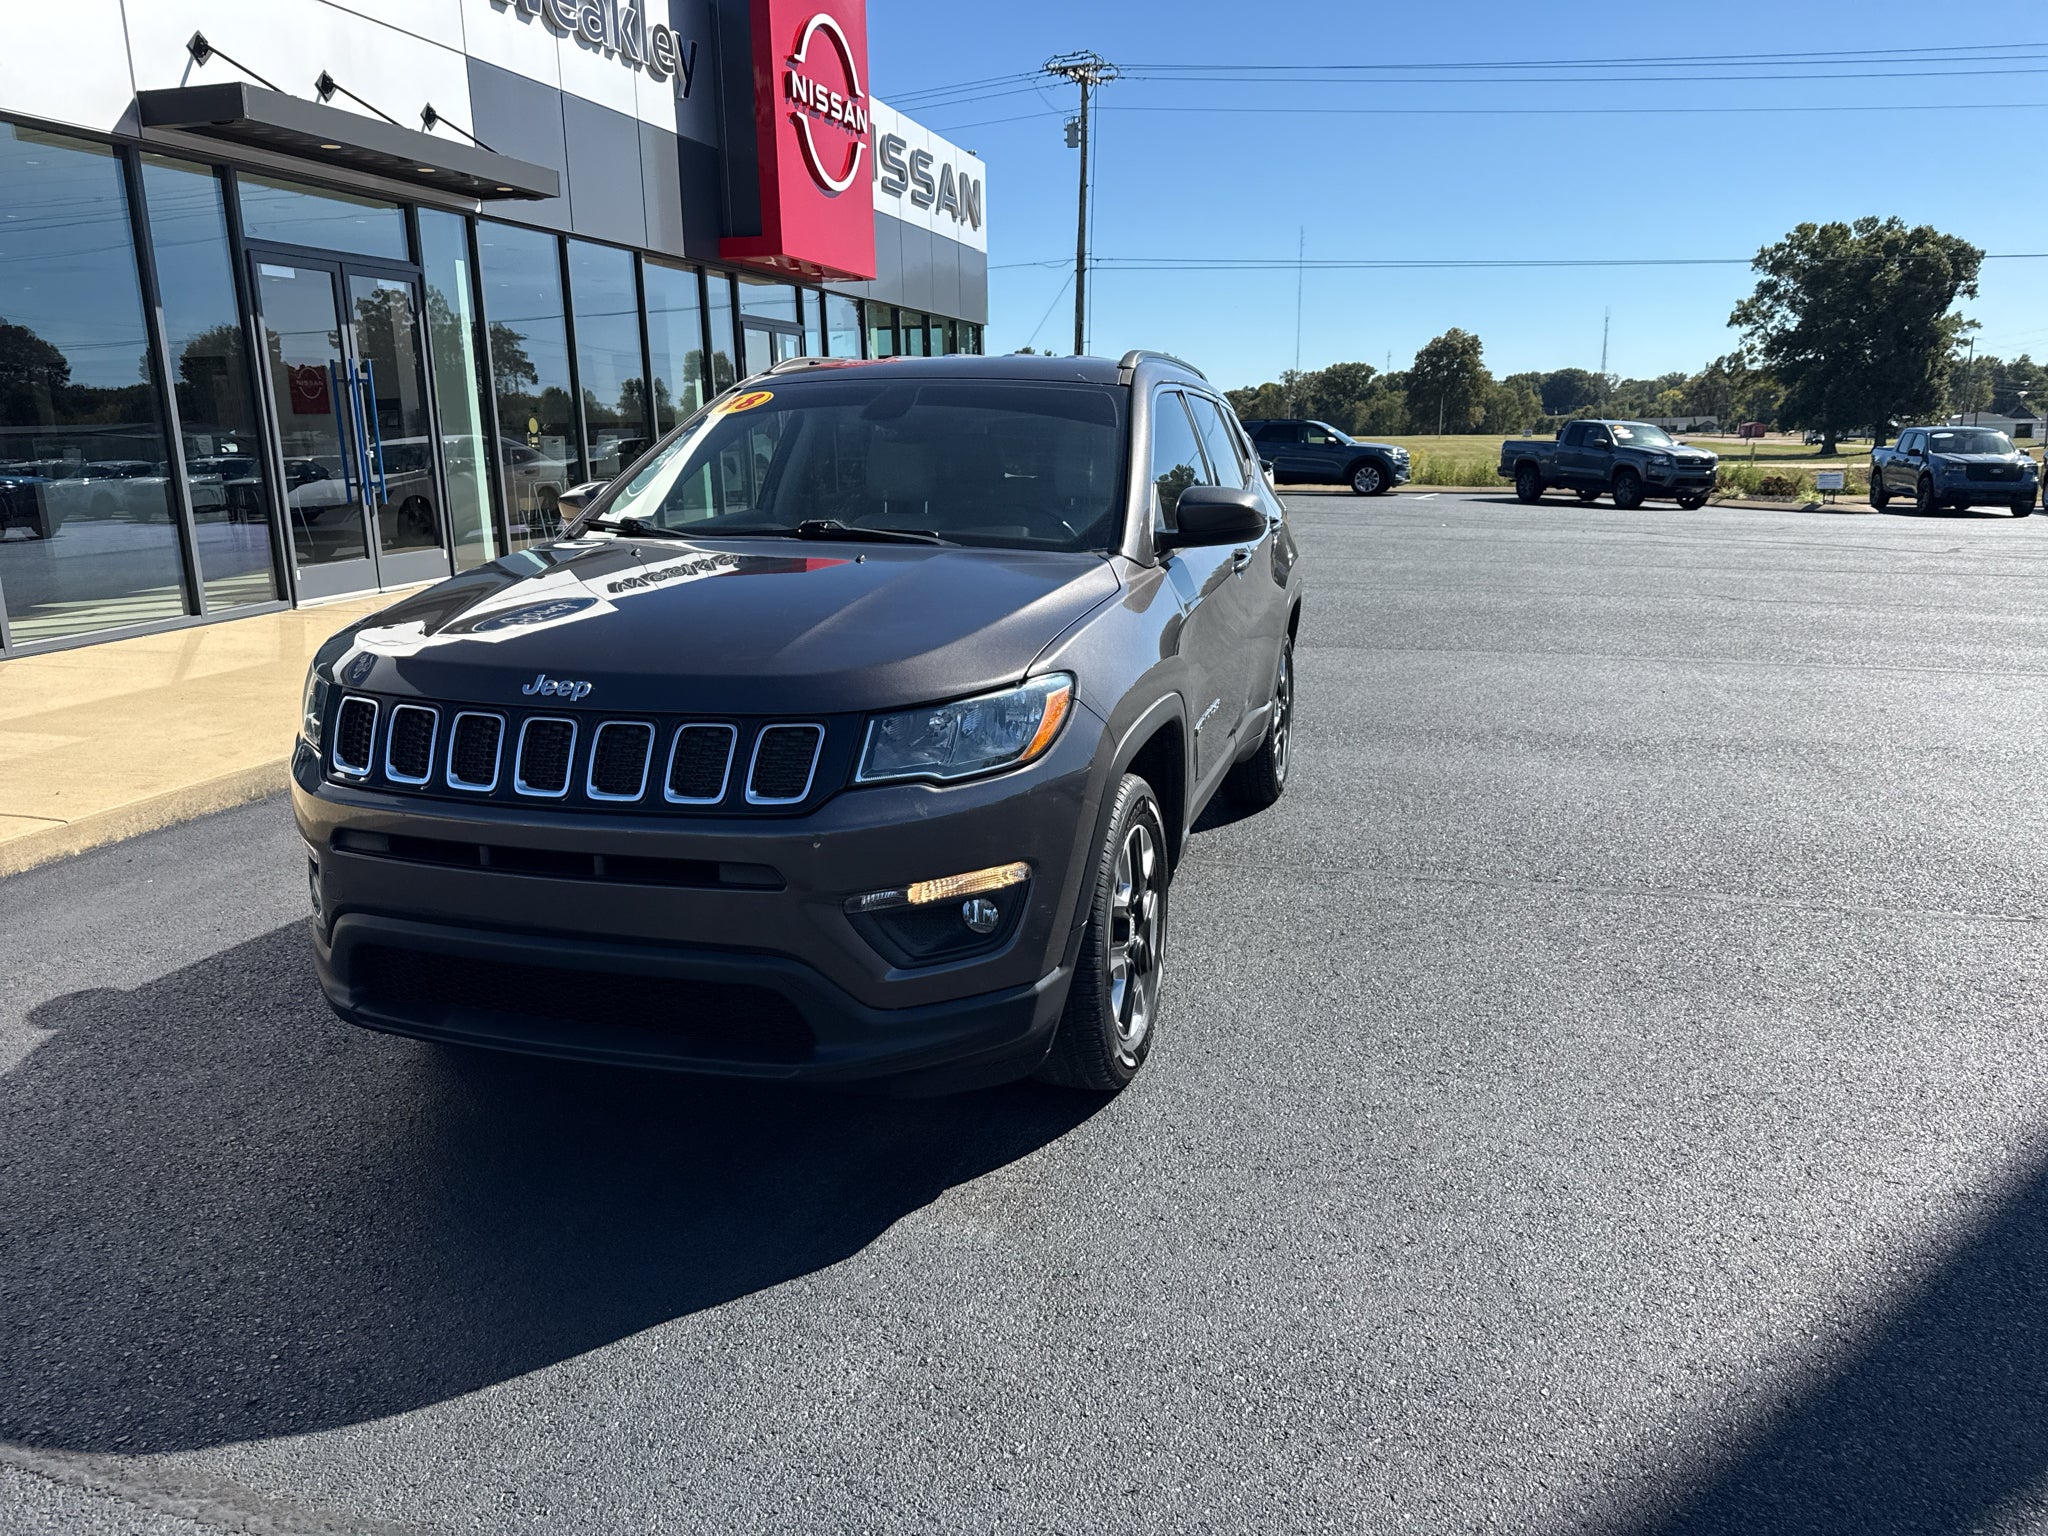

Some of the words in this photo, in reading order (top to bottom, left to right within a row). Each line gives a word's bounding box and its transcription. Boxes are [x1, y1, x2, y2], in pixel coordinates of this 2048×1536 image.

[484, 0, 698, 98] eakley
[788, 70, 868, 134] NISSAN
[871, 121, 982, 232] ISSAN
[522, 674, 592, 701] Jeep
